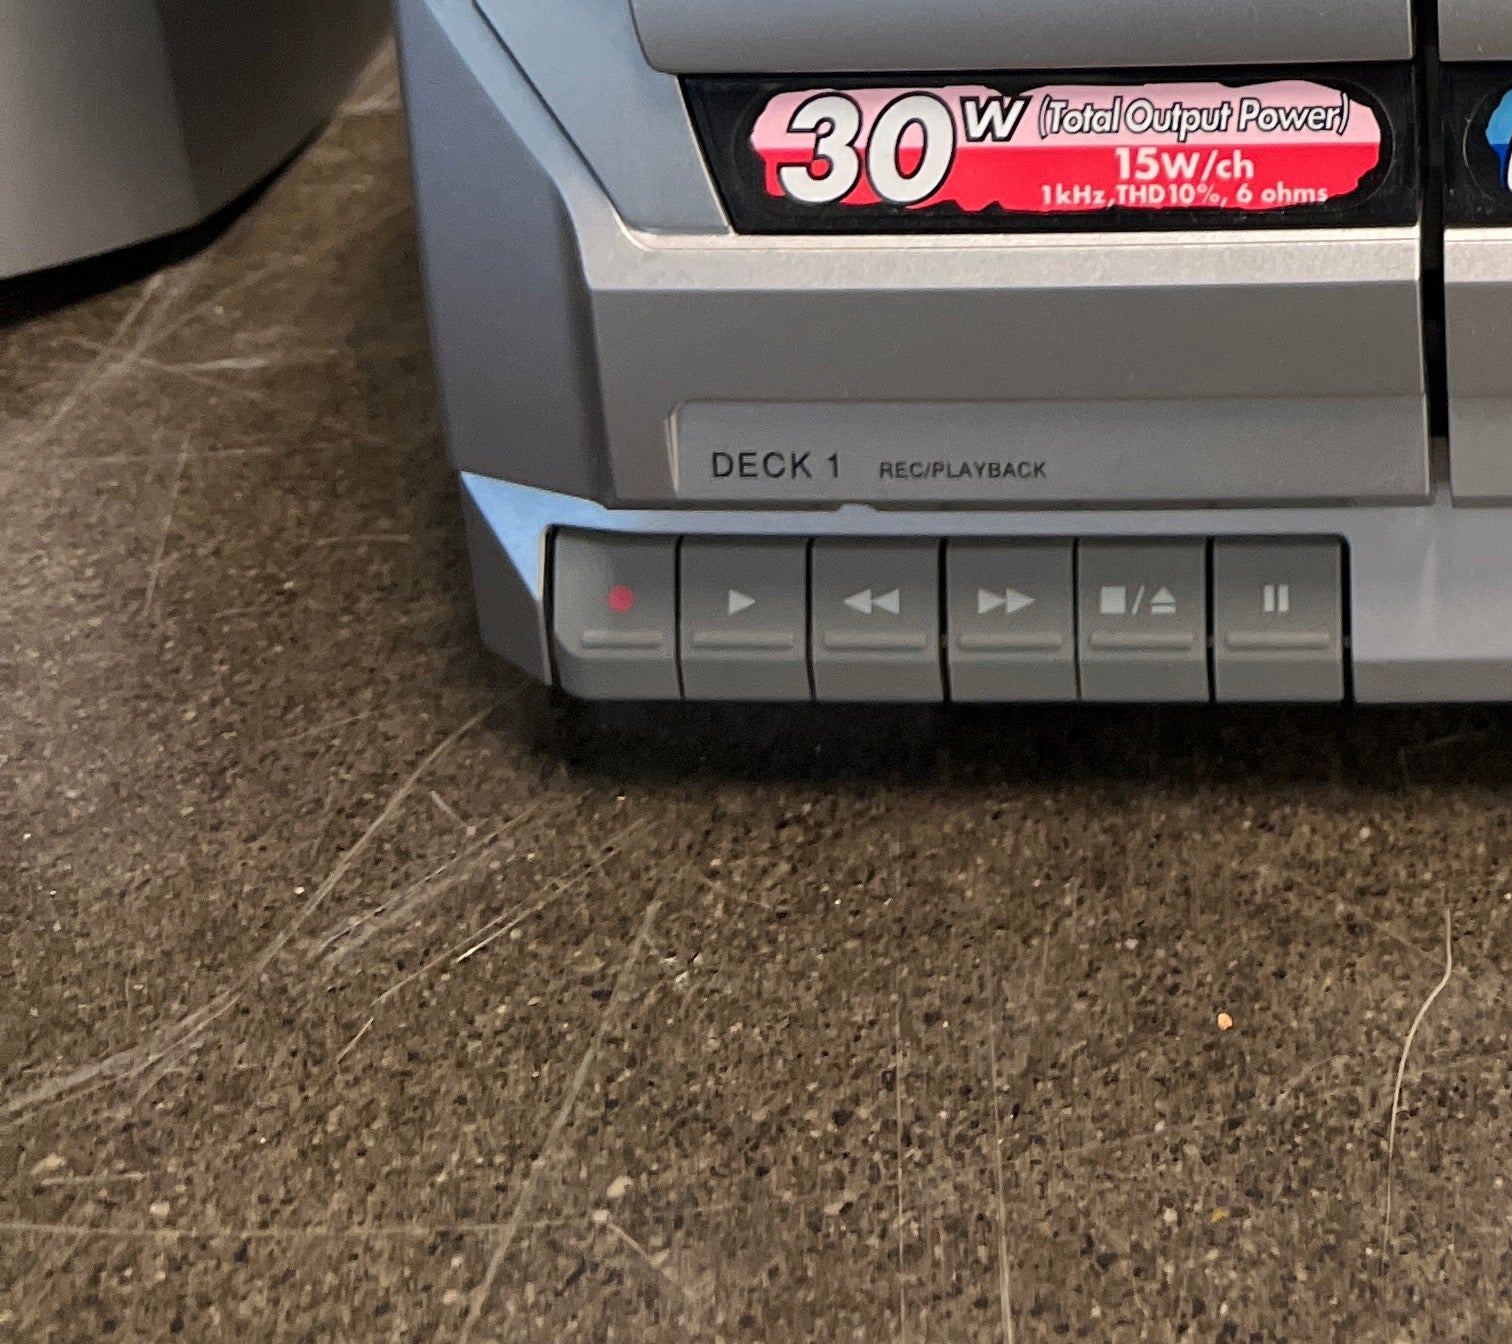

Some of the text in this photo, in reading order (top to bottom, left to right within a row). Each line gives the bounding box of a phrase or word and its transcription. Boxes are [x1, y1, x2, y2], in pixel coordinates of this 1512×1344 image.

[1038, 93, 1125, 140] (Total
[1124, 97, 1234, 144] Output
[1237, 91, 1350, 137] Power)
[1114, 146, 1255, 183] 15W/ch
[1235, 182, 1254, 204] 6
[1260, 180, 1329, 205] ohms
[711, 451, 841, 480] DECK 1
[877, 459, 1048, 481] REC/PLAYBACK
